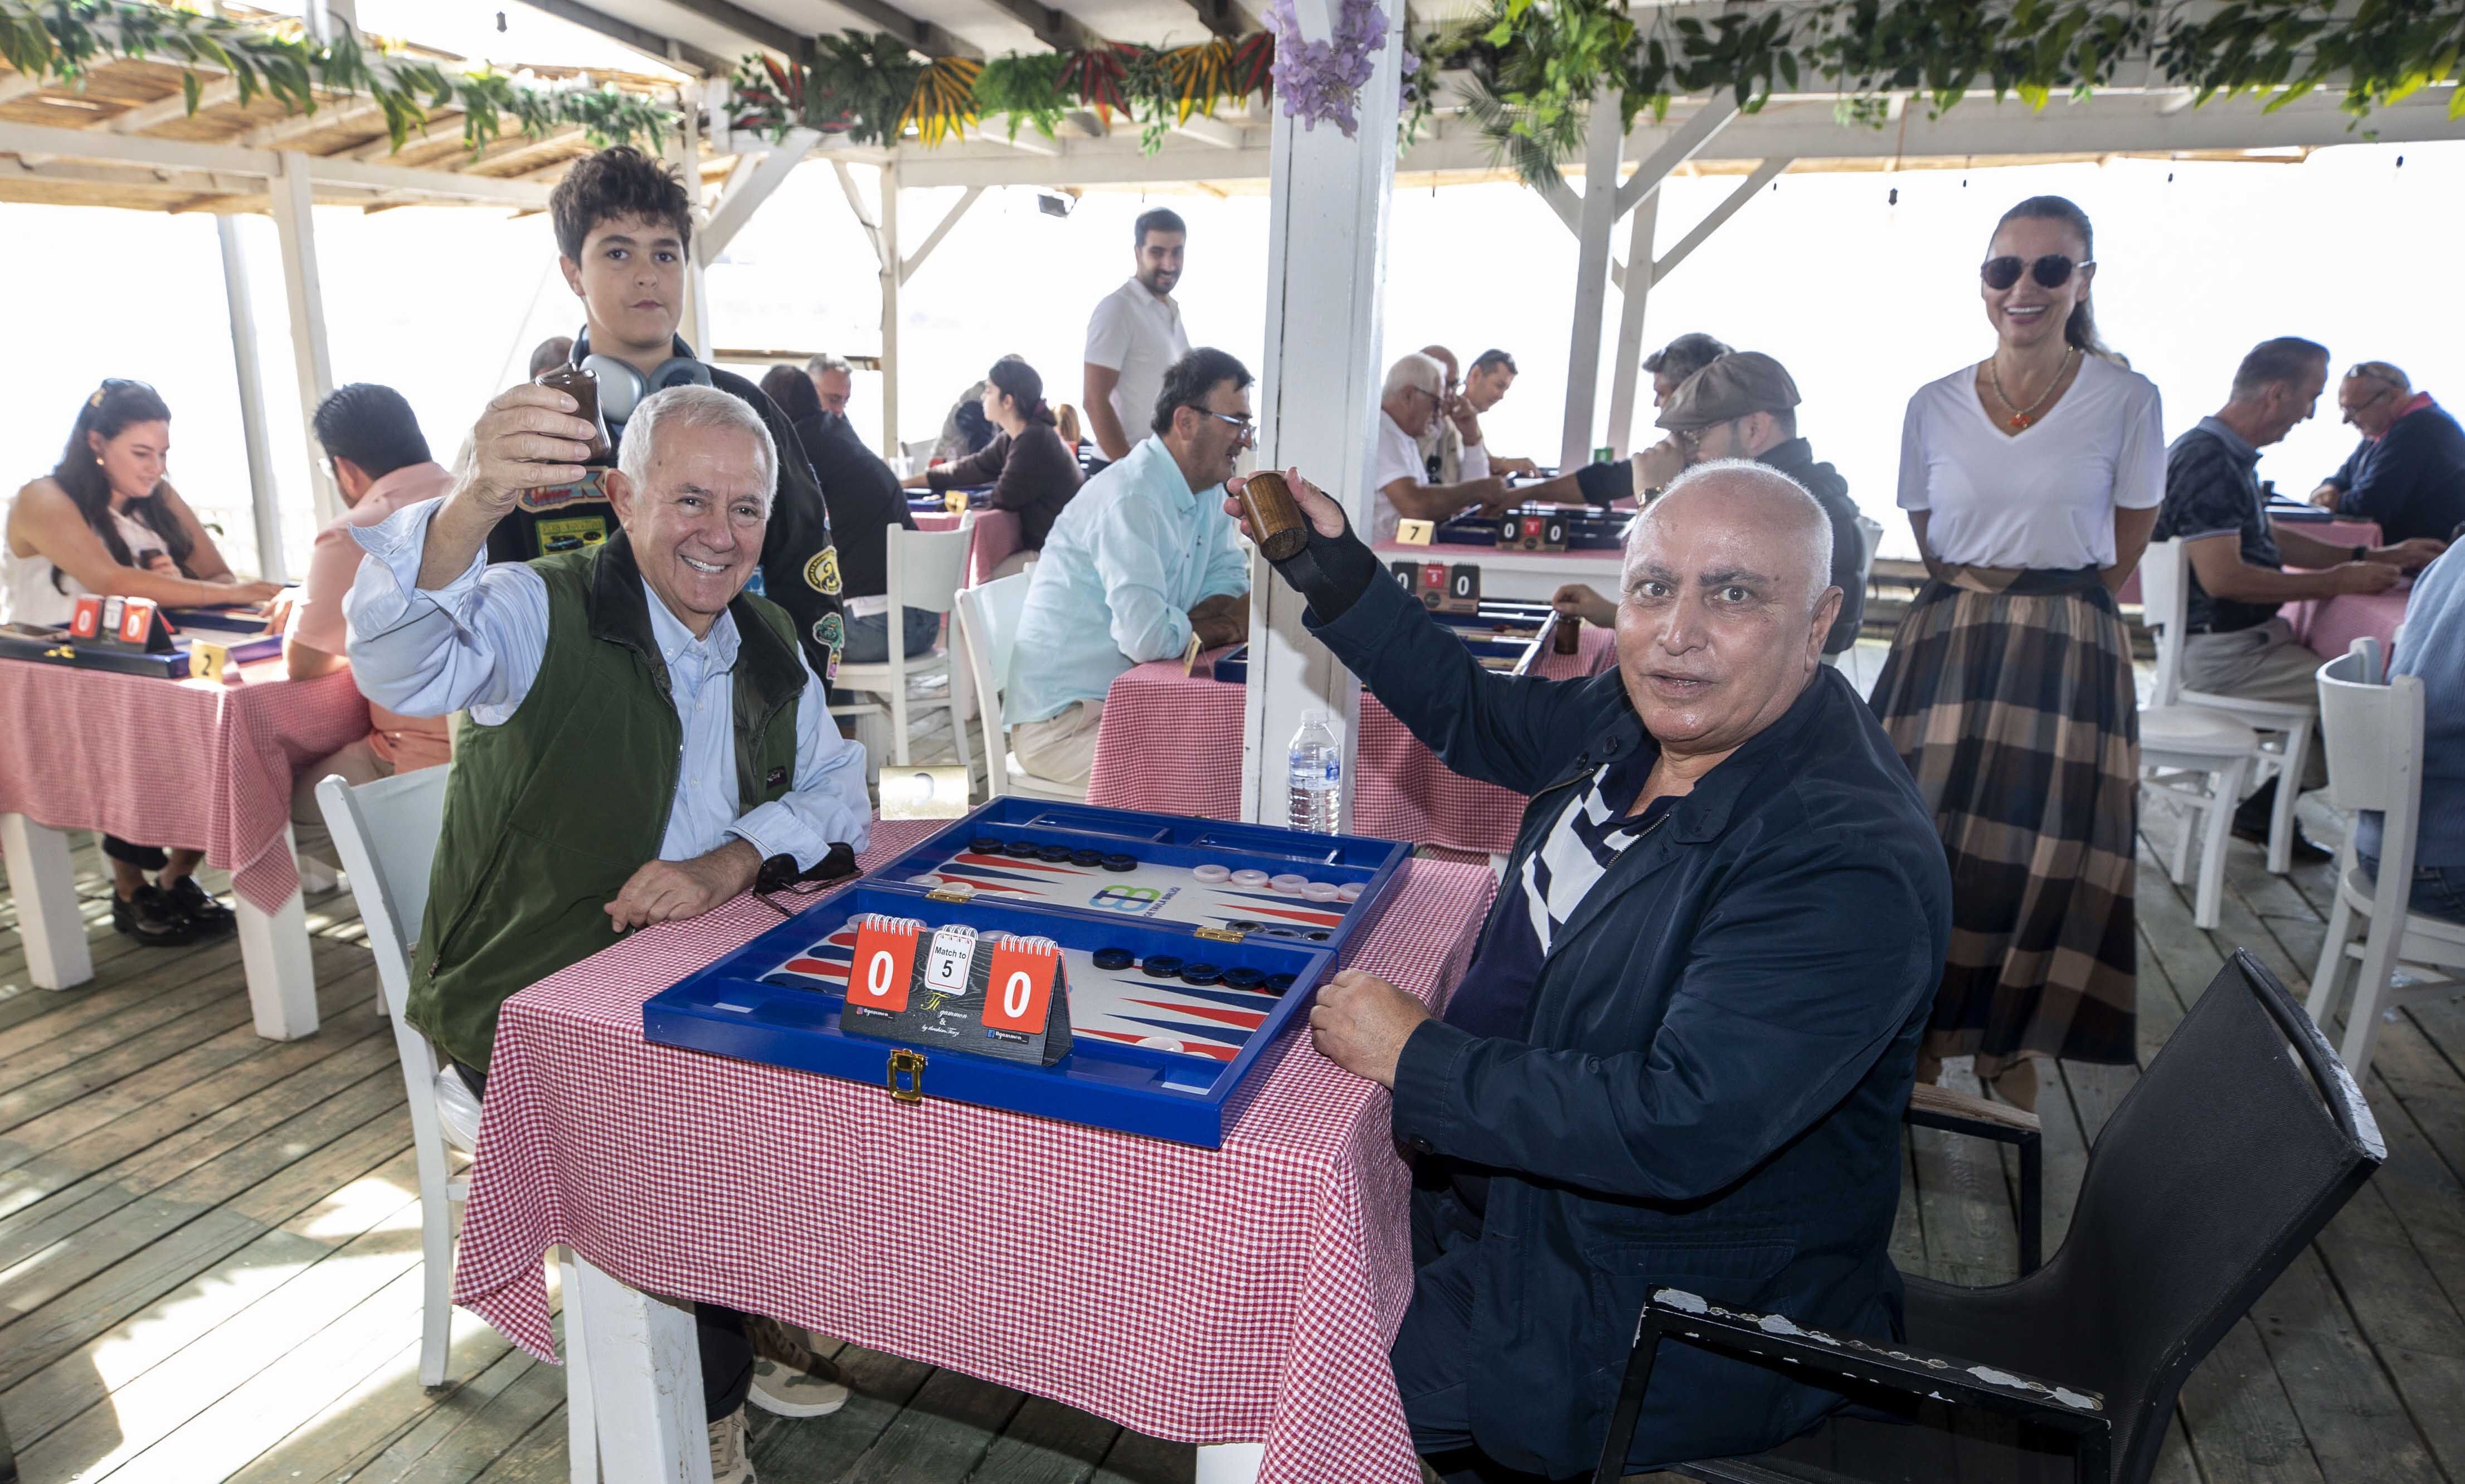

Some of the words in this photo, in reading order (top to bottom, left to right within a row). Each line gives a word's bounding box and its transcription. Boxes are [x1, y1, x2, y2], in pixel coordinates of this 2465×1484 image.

[1410, 526, 1421, 540] 7
[1504, 523, 1515, 538] 0
[1550, 525, 1561, 541] 0
[1457, 576, 1470, 596] 0
[77, 609, 91, 632] 0
[127, 615, 140, 638] 0
[201, 653, 211, 675] 2
[935, 946, 957, 957] Match
[868, 950, 894, 996] 0
[942, 960, 954, 977] 5
[1004, 971, 1032, 1018] 0
[936, 1010, 967, 1019] gammon
